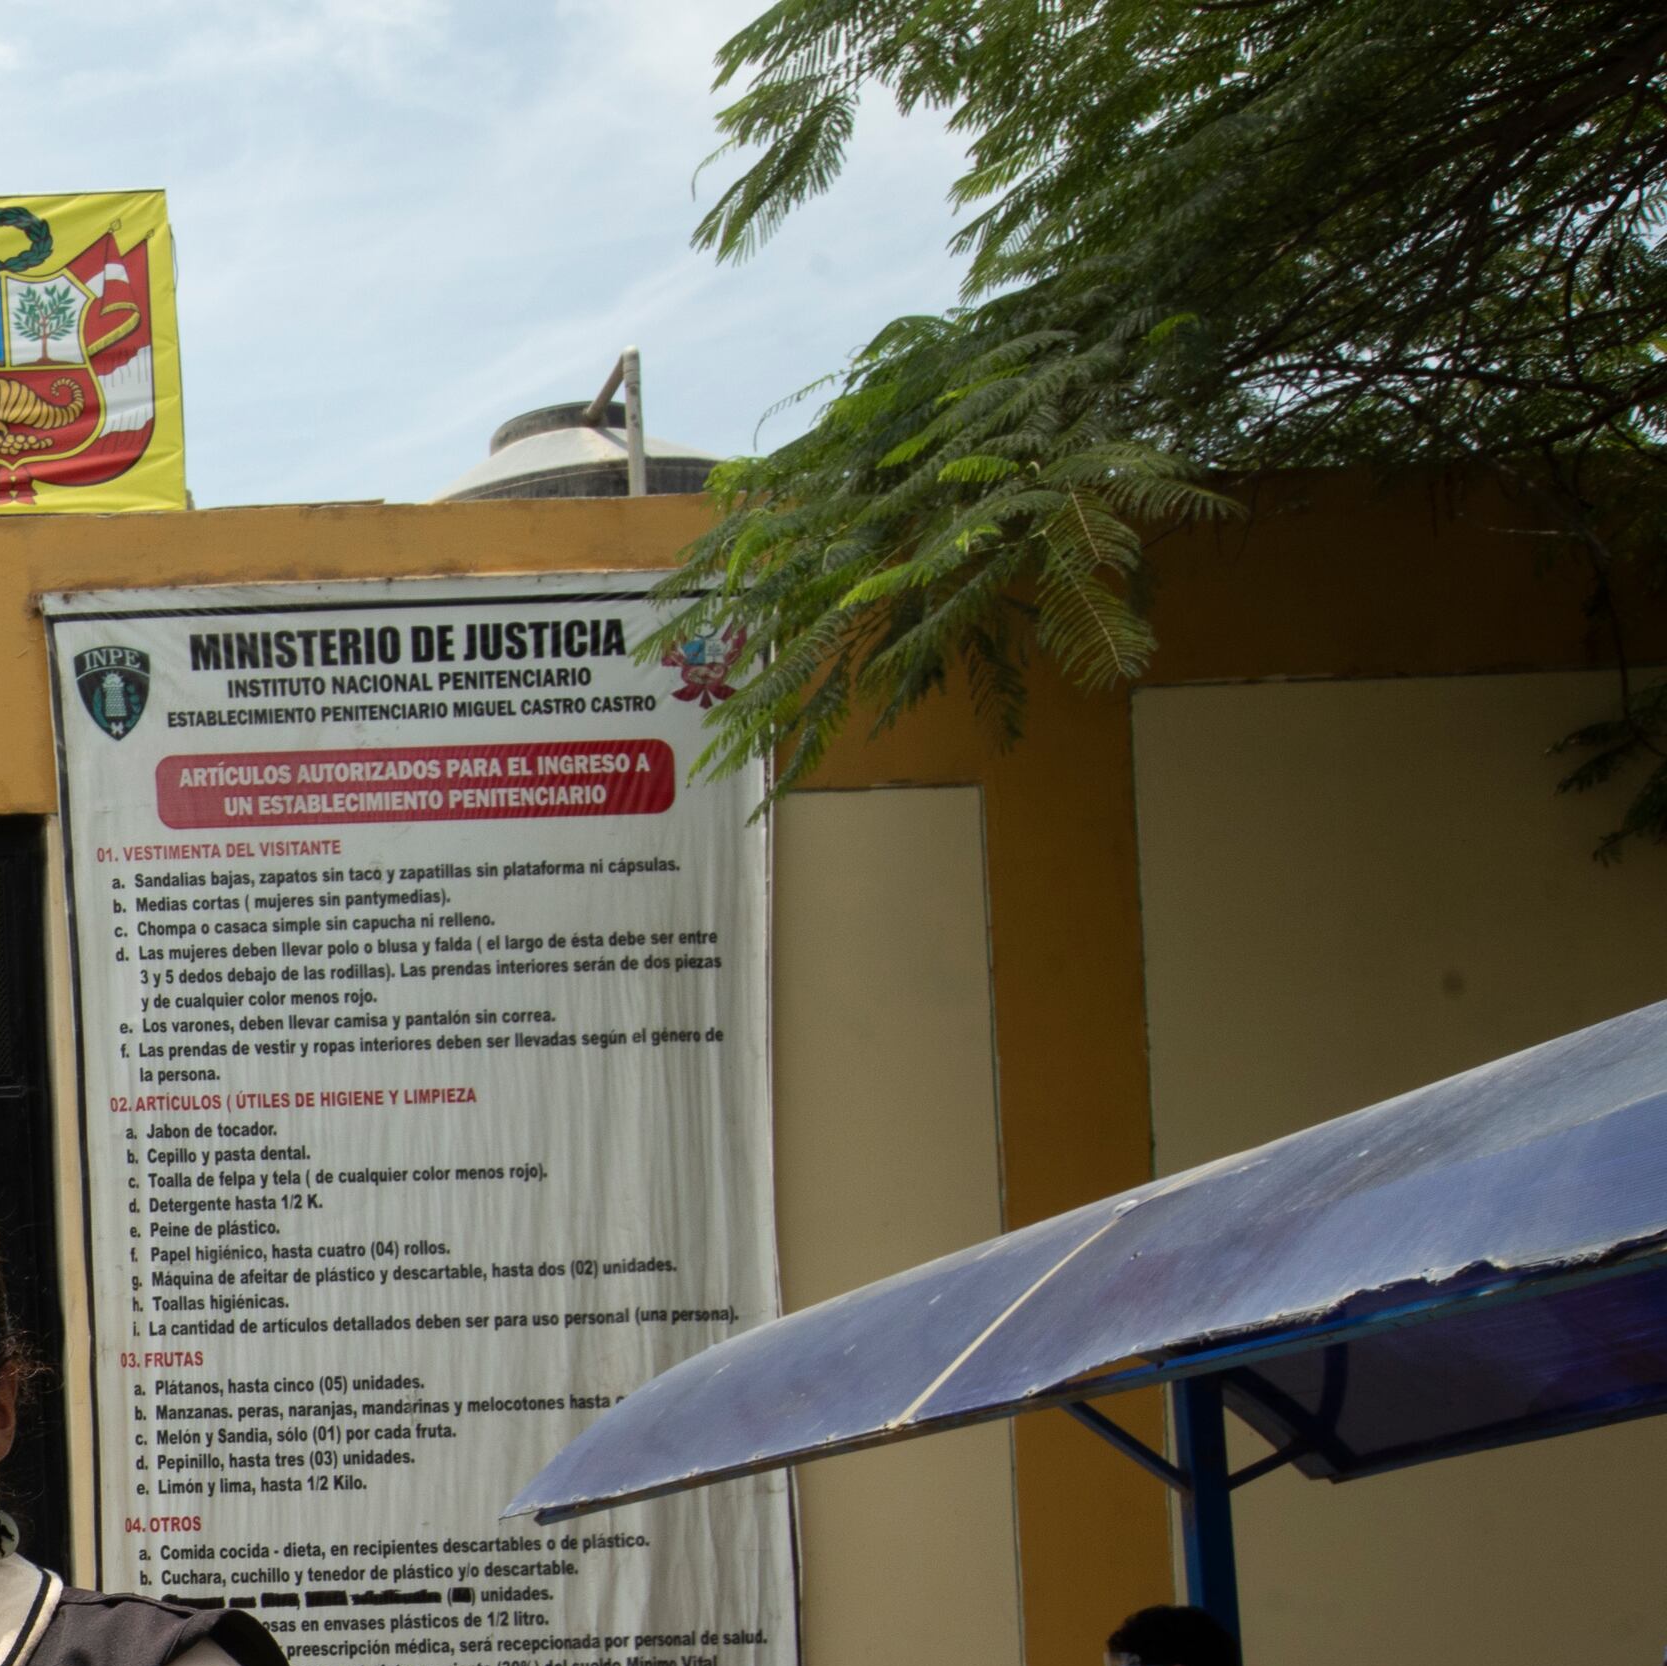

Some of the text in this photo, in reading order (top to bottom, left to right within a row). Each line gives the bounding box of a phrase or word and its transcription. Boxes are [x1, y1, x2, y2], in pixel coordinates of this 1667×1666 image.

[83, 647, 141, 671] INPE
[190, 619, 626, 671] MINISTERIO DE JUSTICIA
[228, 667, 592, 698] INSTITUTO NACIONAL PENITENCIARIO
[168, 695, 657, 728] ESTABLECIMIENTO PENITENCIARIO MIGUEL CASTRO CASTRO
[177, 753, 650, 791] ARTÍCULOS AUTORIZADOS PARA EL INGRESO A
[223, 785, 606, 817] UN ESTABLECIMIENTO PENITENCIARIO
[97, 840, 341, 863] 01. VESTIMENTA DEL VISITANTE
[112, 878, 125, 889] a.
[135, 872, 206, 888] Sandalias
[211, 870, 255, 889] bajas,
[259, 869, 318, 888] zapatos
[322, 867, 344, 882] sin
[387, 869, 395, 884] y
[399, 863, 472, 883] zapatillas
[476, 862, 499, 878] sin
[503, 860, 586, 881] plataforma
[589, 858, 604, 874] ni
[608, 856, 681, 877] cápsulas.
[110, 1097, 132, 1112] 02.
[135, 1094, 221, 1112] ARTÍCULOS
[236, 1091, 290, 1109] ÚTILES
[295, 1092, 315, 1108] DE
[320, 1090, 384, 1107] HIGIENE
[389, 1090, 398, 1105] Y
[404, 1087, 477, 1105] LIMPIEZA
[129, 1219, 280, 1239] e. Peine de plástico.
[120, 1351, 203, 1368] 03. FRUTAS
[136, 1474, 367, 1498] e. Limón y lima, hasta 1/2 Kilo.
